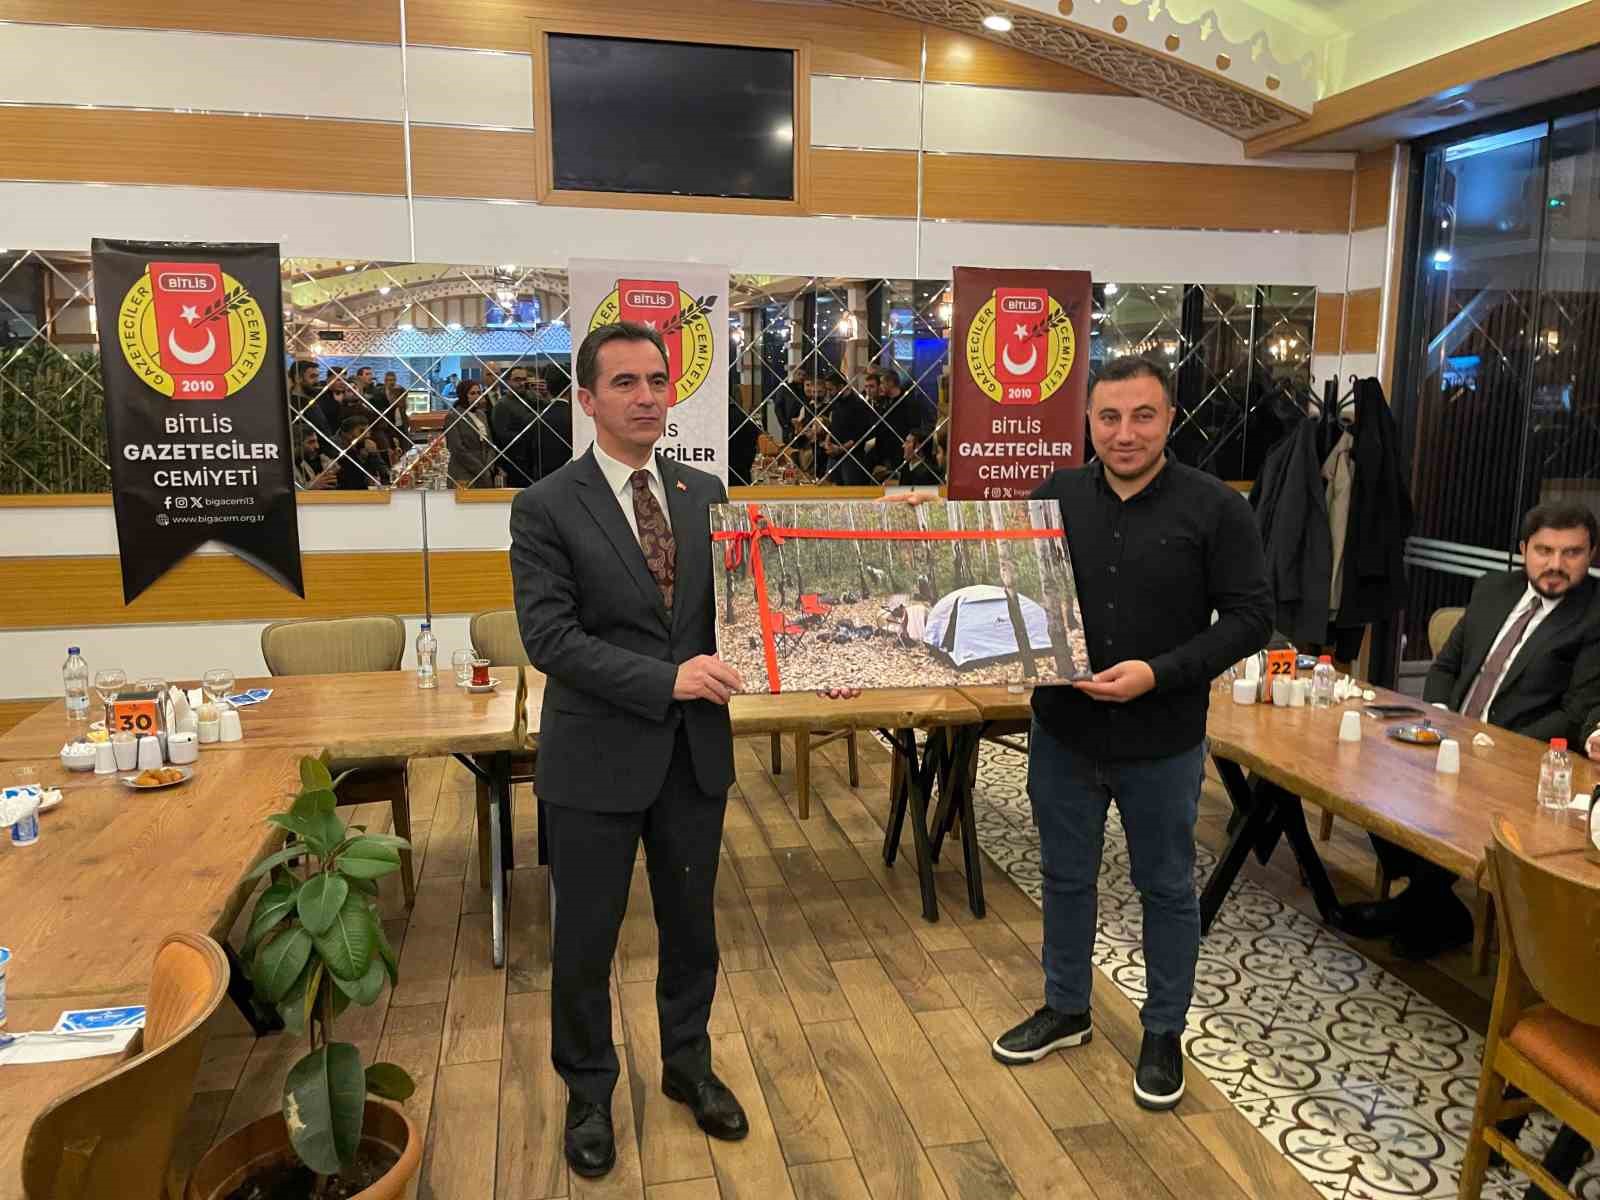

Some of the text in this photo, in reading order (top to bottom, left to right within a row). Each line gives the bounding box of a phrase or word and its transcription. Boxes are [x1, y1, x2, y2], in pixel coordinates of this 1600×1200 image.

[168, 277, 208, 289] BİTLİS
[633, 293, 666, 305] BİTLİS
[1008, 300, 1037, 310] BİTLİS
[182, 380, 215, 392] 2010
[1008, 388, 1032, 399] 2010
[165, 412, 233, 434] BİTLİS
[992, 416, 1041, 434] BİTLİS
[123, 439, 279, 460] GAZETECİLER
[959, 438, 1073, 457] GAZETECİLER
[153, 465, 258, 486] CEMİYETİ
[978, 461, 1054, 479] CEMİYETİ
[1271, 661, 1292, 675] 22
[119, 713, 152, 731] 30
